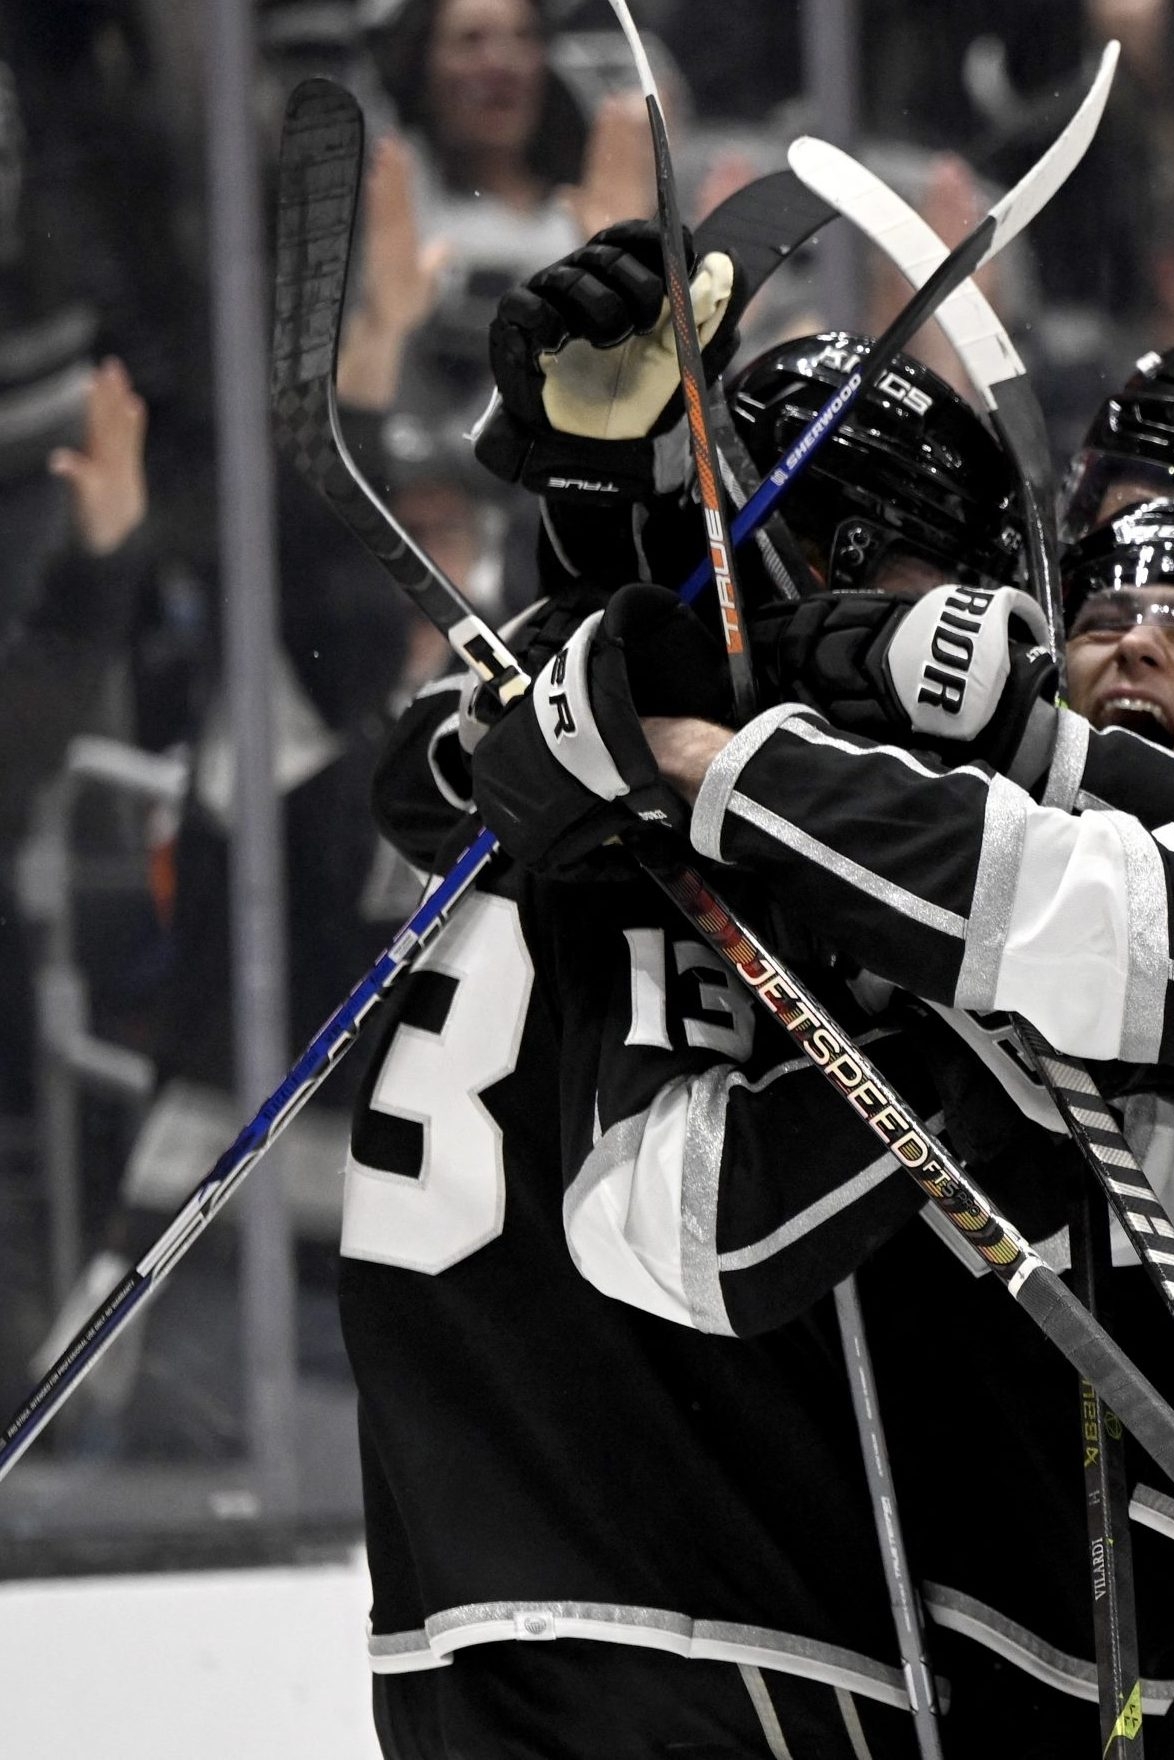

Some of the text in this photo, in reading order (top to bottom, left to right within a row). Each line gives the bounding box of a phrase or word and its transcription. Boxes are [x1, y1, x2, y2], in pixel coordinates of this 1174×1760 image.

[786, 372, 863, 470] SHERWOOD
[547, 476, 620, 494] TRUE
[704, 508, 737, 648] TRUE
[622, 927, 757, 1064] 13
[736, 958, 929, 1170] JETSPEED
[1091, 1536, 1107, 1602] VILARDI
